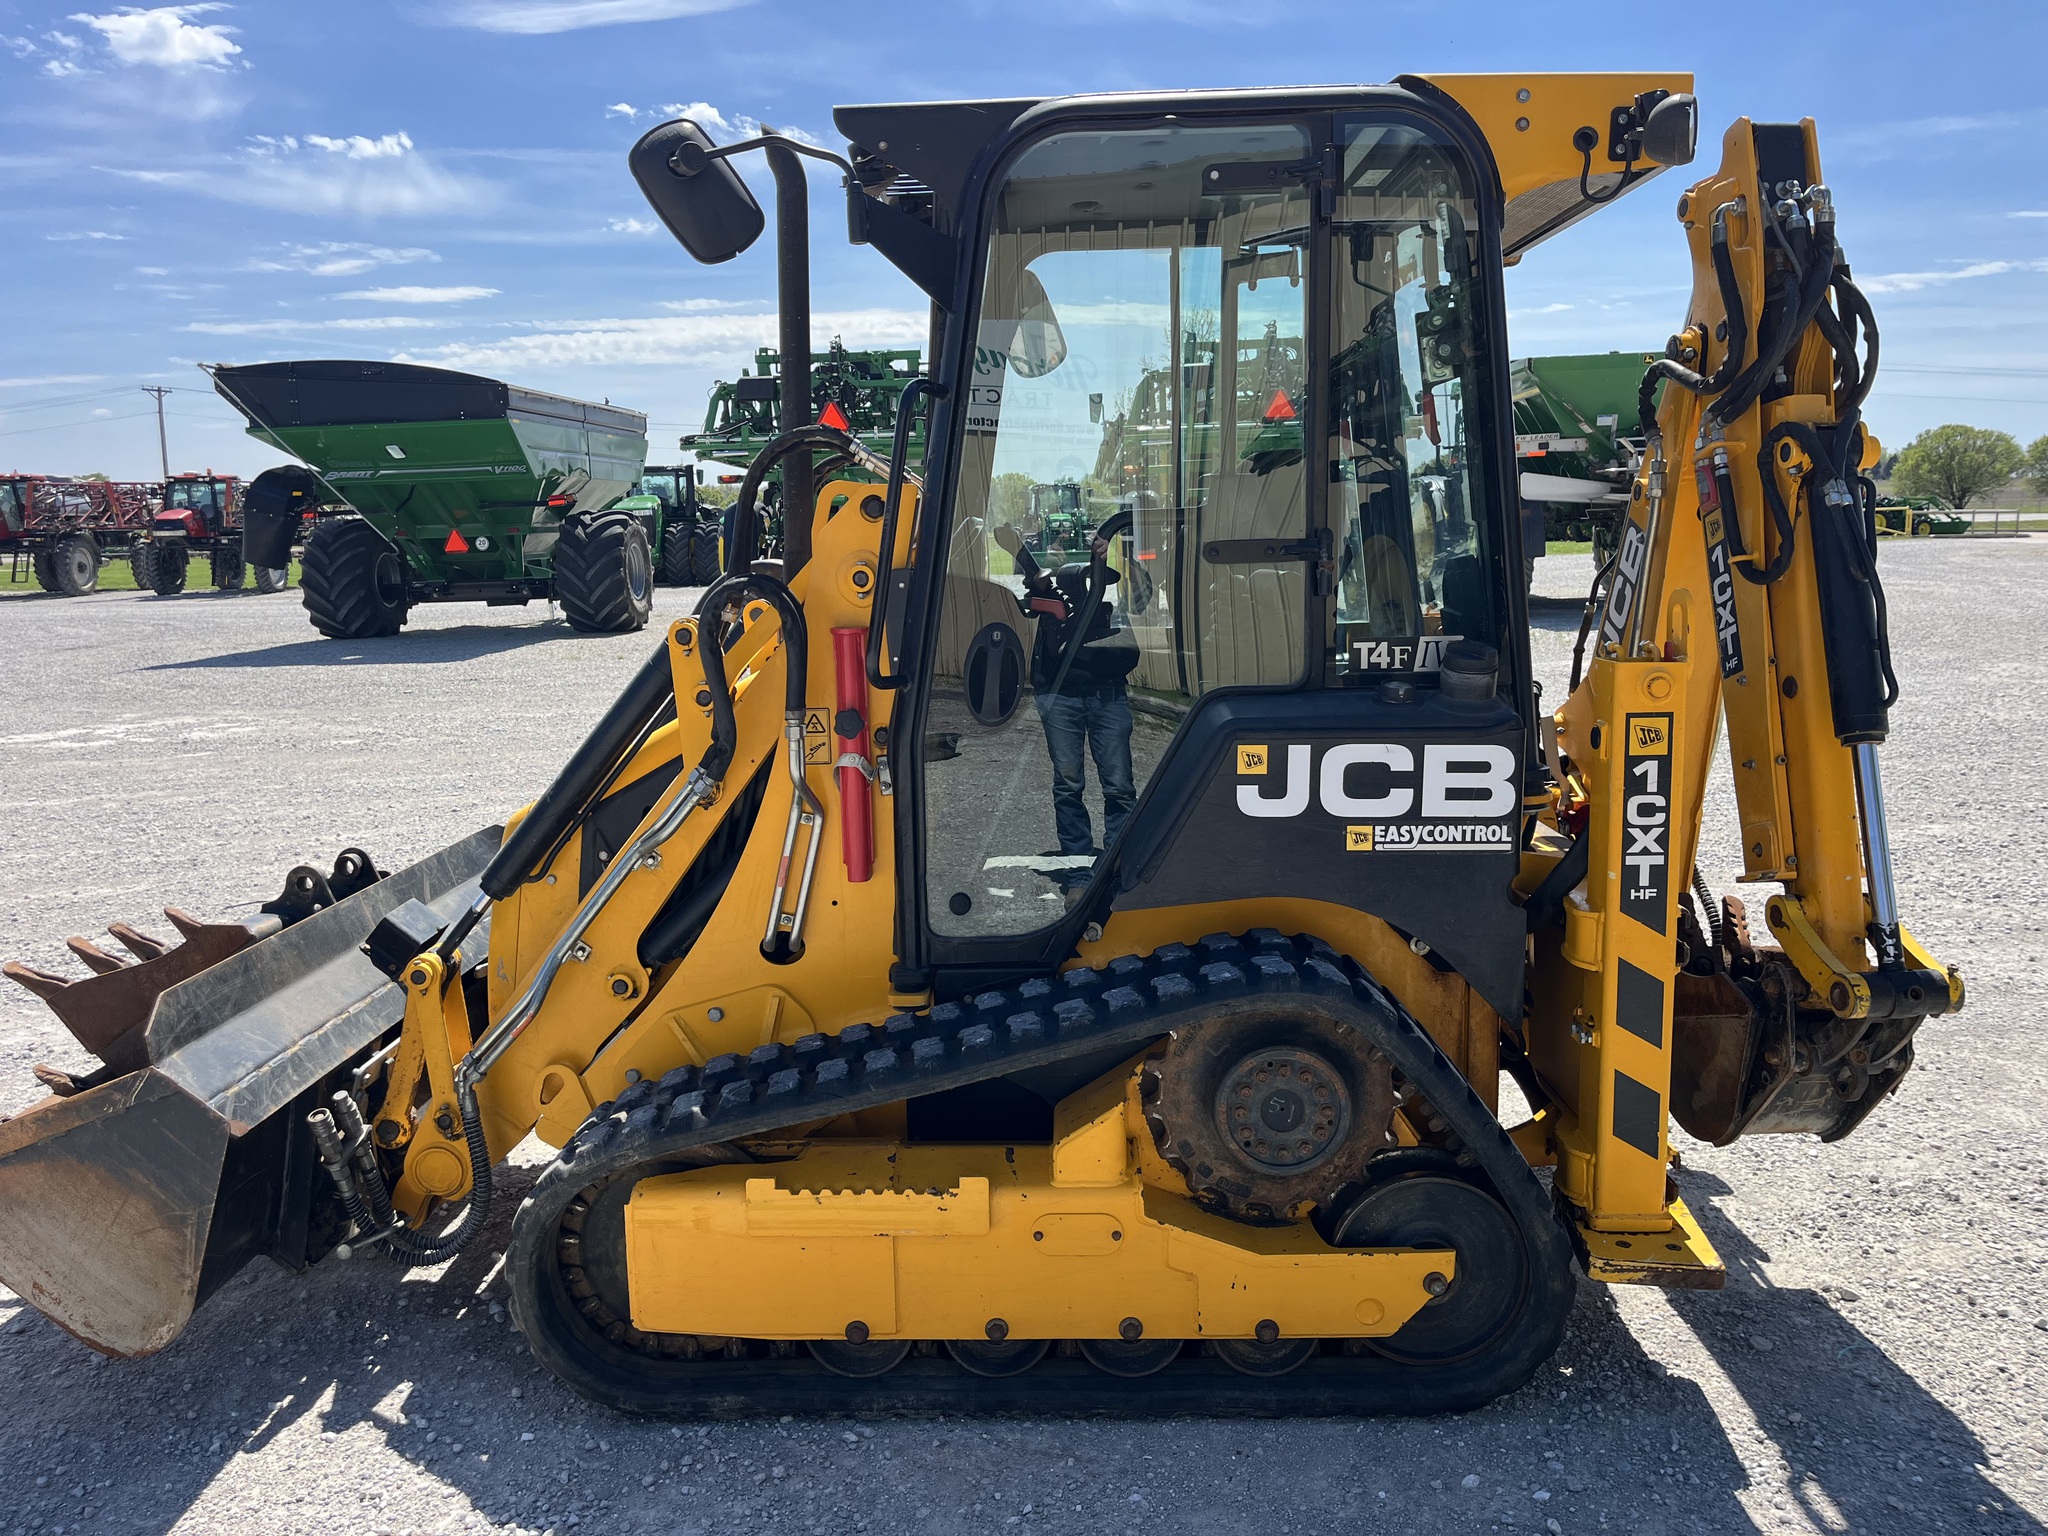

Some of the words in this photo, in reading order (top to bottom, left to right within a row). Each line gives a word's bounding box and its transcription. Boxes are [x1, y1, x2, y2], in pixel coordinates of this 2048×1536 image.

[324, 470, 375, 481] BRENT
[1711, 544, 1738, 655] 1CXT
[1725, 657, 1739, 671] HF
[1640, 725, 1662, 745] JCB
[1245, 752, 1263, 767] JCB
[1236, 743, 1516, 818] JCB
[1625, 760, 1667, 887] 1CXT
[1353, 832, 1370, 845] JCB
[1374, 825, 1513, 845] EASYCONTROL
[1630, 888, 1658, 900] HF
